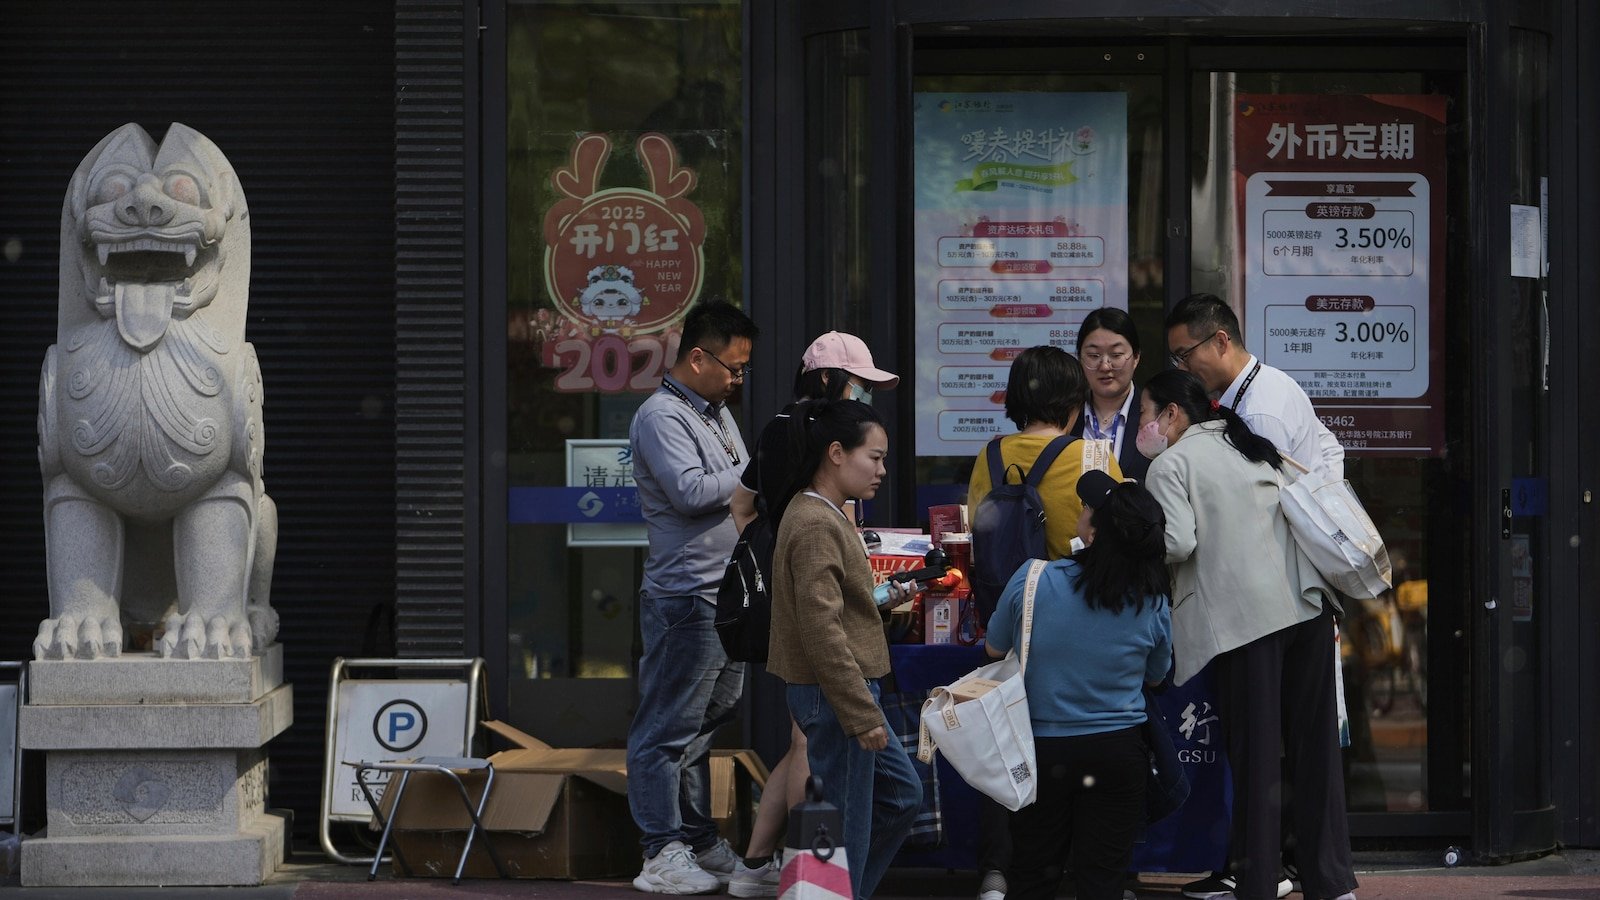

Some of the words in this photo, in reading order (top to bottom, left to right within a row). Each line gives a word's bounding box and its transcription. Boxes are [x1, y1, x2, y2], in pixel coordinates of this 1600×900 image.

[960, 126, 1096, 162] 暖春提升礼
[1265, 122, 1415, 160] 外币定期
[1325, 184, 1354, 194] 享赢宝
[602, 206, 646, 220] 2025
[1316, 205, 1363, 217] 英镑存款
[987, 224, 1055, 235] 资产达标大礼包
[1266, 230, 1321, 240] 5000英镑起存
[569, 221, 679, 259] 开门红
[1334, 227, 1411, 249] 3.50%
[1272, 245, 1313, 257] 6个月期
[646, 260, 682, 269] HAPPY
[1349, 255, 1383, 264] 年化利率
[657, 271, 682, 281] NEW
[654, 284, 682, 293] YEAR
[1316, 298, 1363, 310] 美元存款
[1006, 307, 1037, 316] 立即领取
[1268, 327, 1325, 337] 5000美元起存
[1334, 321, 1409, 343] 3.00%
[1283, 342, 1312, 354] 1年期
[1349, 351, 1383, 360] 年化利率
[1027, 580, 1036, 598] CBD
[1025, 598, 1034, 635] BEIJING
[945, 709, 957, 728] CBD
[1178, 701, 1220, 746] 行
[389, 712, 416, 743] P
[1177, 749, 1218, 764] GSU
